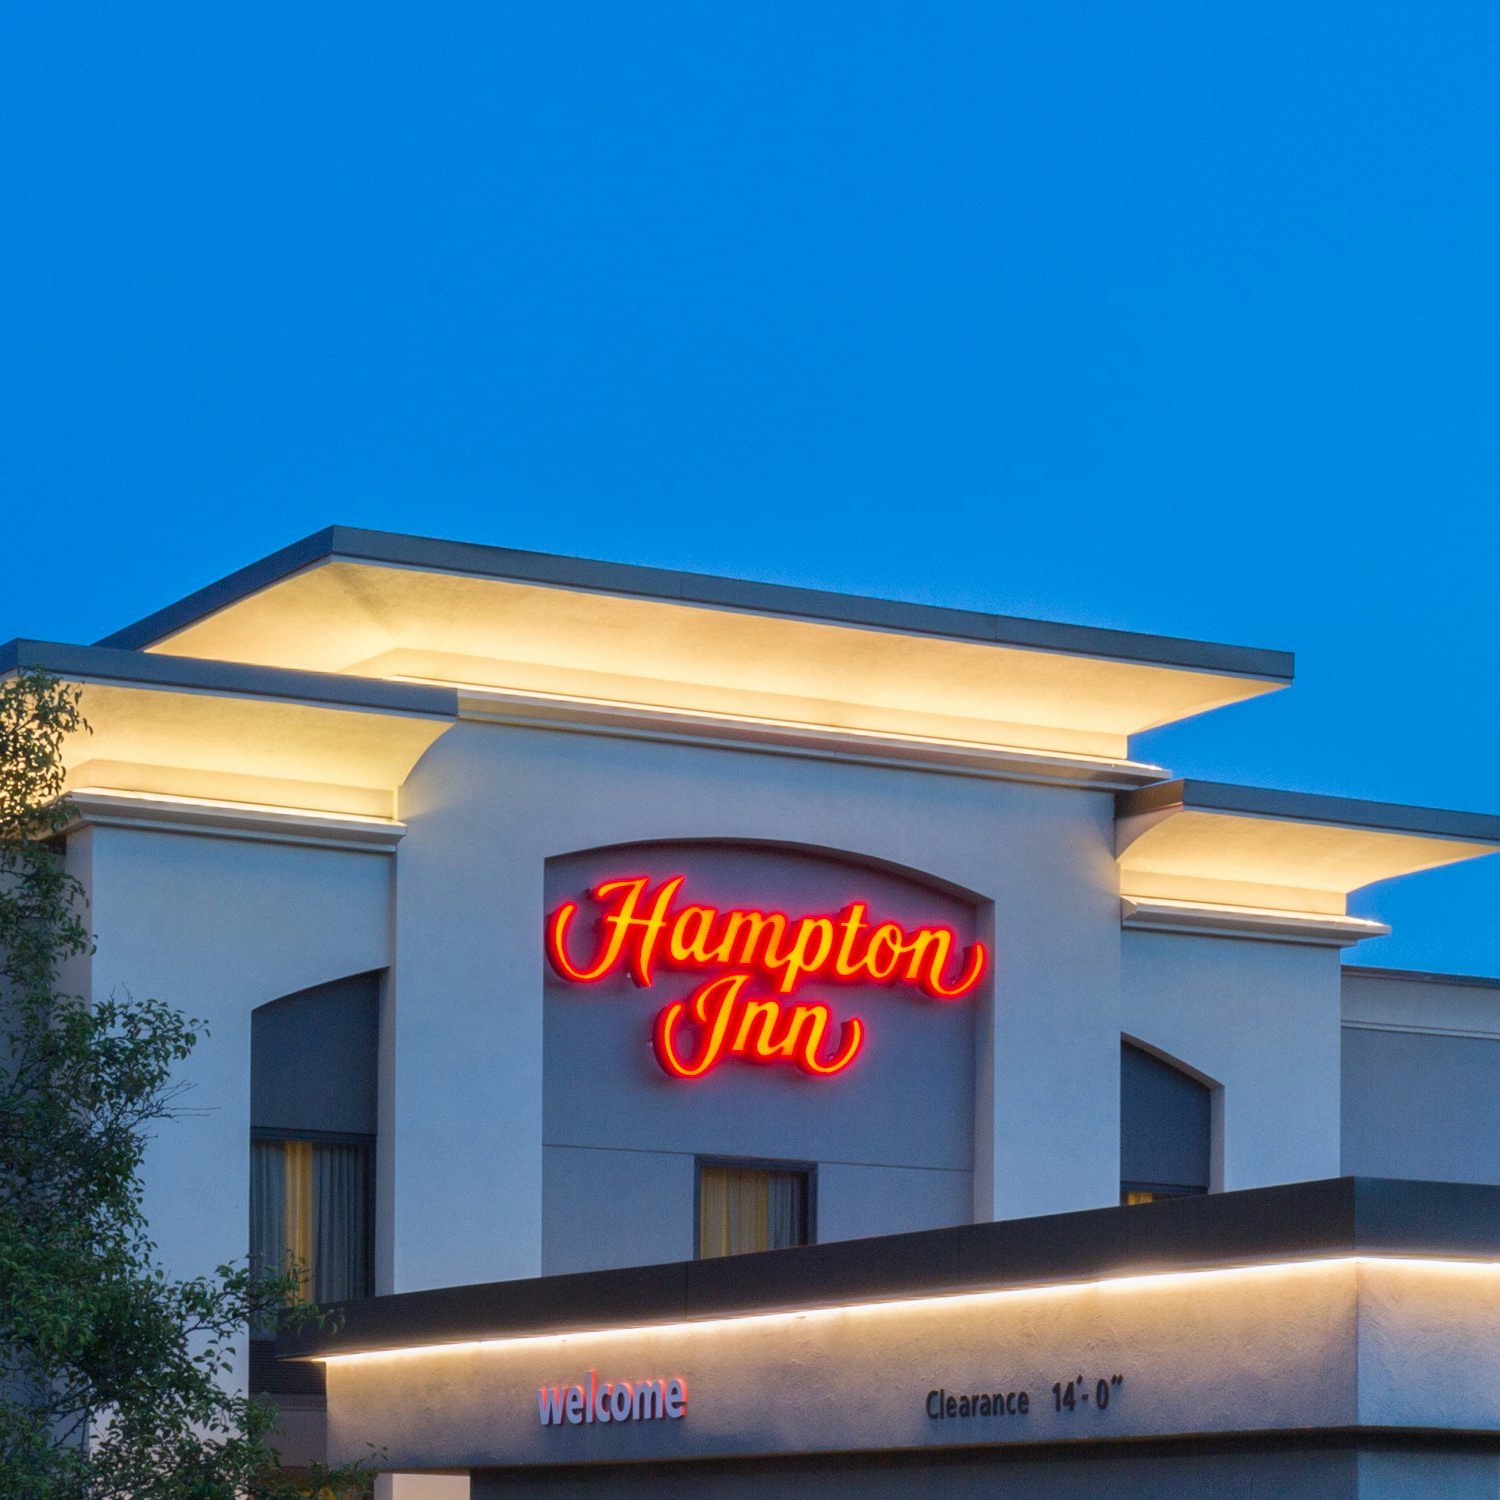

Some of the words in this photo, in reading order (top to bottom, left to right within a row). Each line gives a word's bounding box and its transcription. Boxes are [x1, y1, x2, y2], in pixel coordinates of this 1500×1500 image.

[547, 875, 987, 998] Hampton
[653, 973, 864, 1079] Inn
[536, 1368, 688, 1426] welcome
[925, 1388, 1030, 1420] Clearance
